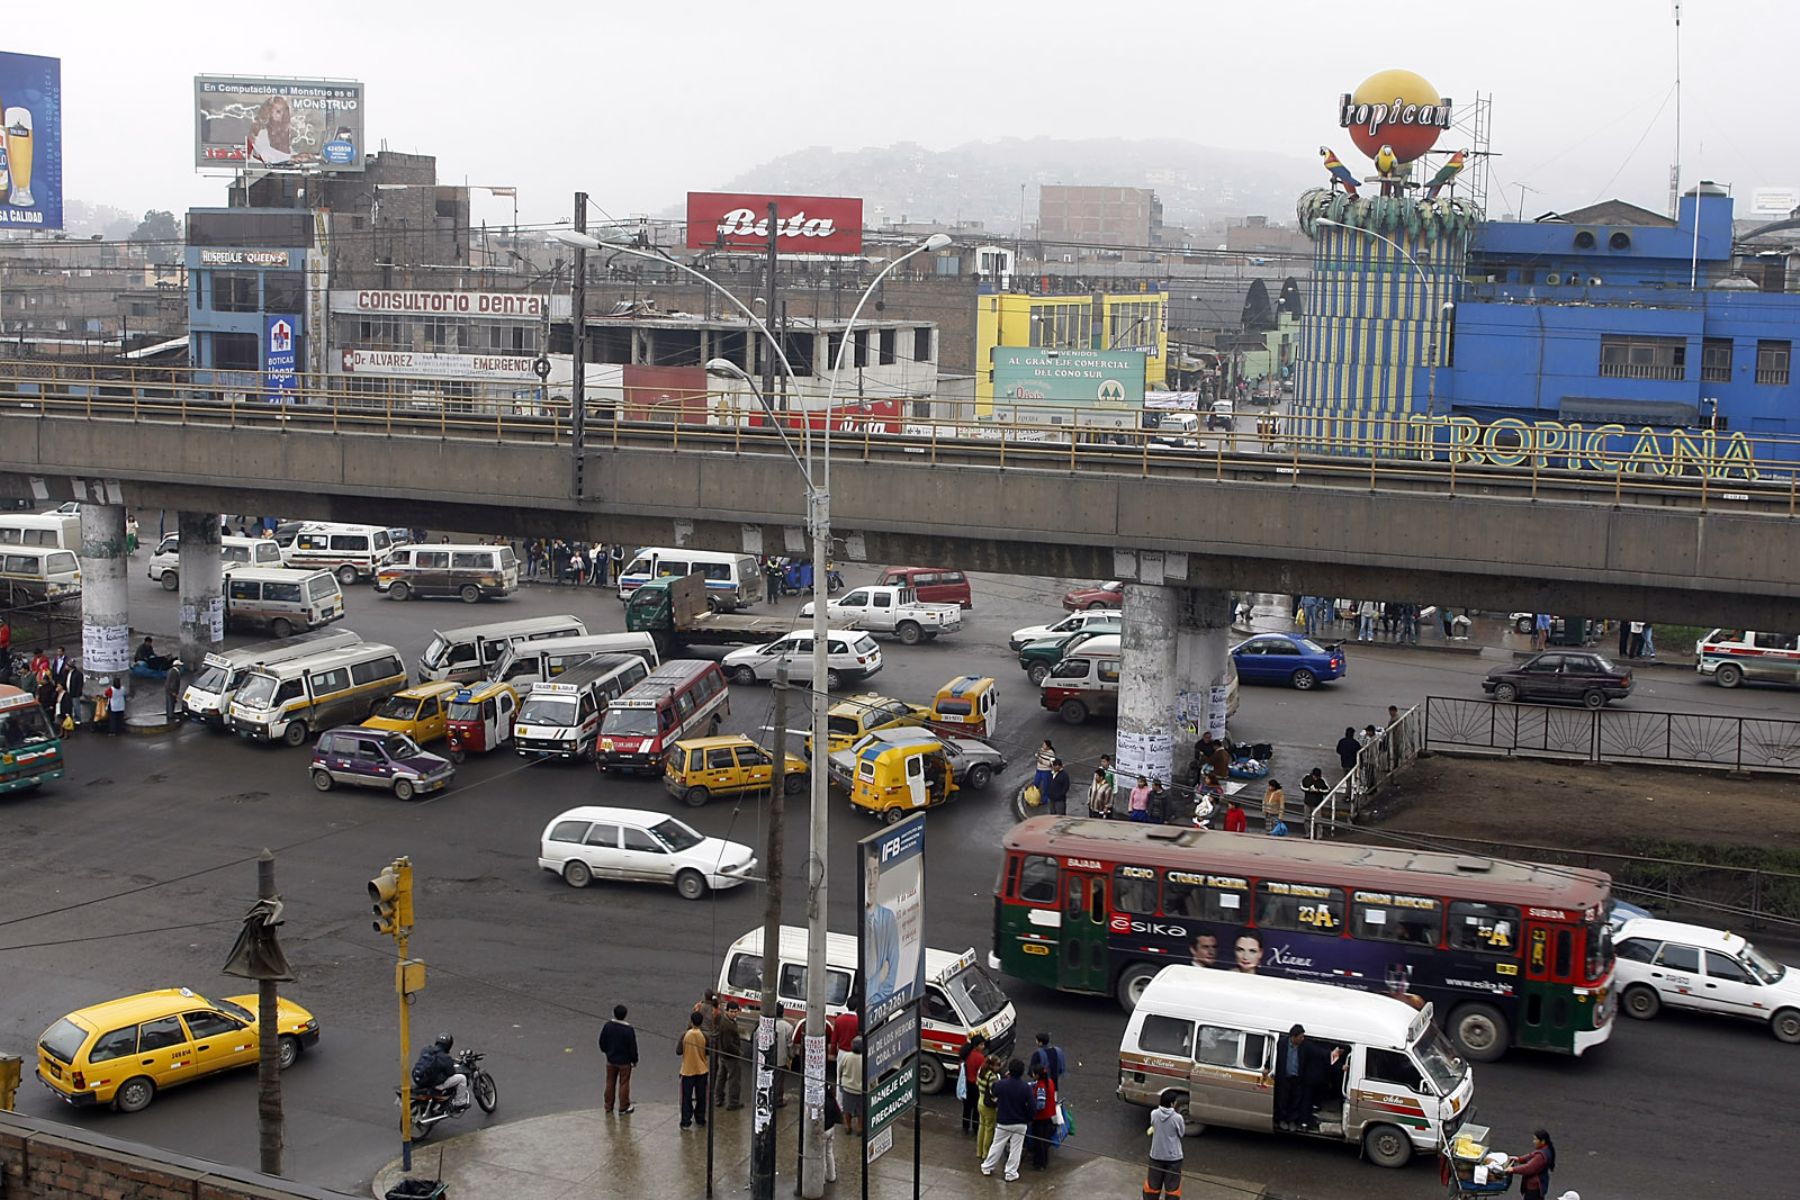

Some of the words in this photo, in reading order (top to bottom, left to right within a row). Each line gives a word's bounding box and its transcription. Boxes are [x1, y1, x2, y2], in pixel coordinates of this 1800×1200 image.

[204, 83, 216, 91] En
[218, 84, 278, 95] Computación
[279, 86, 288, 94] el
[290, 87, 332, 97] Monstruo
[347, 89, 354, 98] el
[293, 99, 357, 110] MONSTRUO
[10, 209, 43, 224] CALIDAD
[715, 208, 836, 238] Bata
[369, 353, 413, 368] ALVAREZ
[1040, 349, 1098, 357] BIVENIDOS
[268, 356, 294, 366] BOTICAS
[1055, 359, 1073, 367] EJE
[1074, 360, 1131, 369] COMERCIAL
[268, 366, 294, 383] Hogar
[1034, 369, 1053, 377] DEL
[1054, 369, 1082, 378] CONO
[1410, 415, 1760, 480] TROPICANA
[882, 836, 901, 862] IFB
[1067, 858, 1102, 869] BAJADA
[1529, 908, 1566, 920] SUBIDA
[744, 991, 762, 1000] ACH
[883, 1031, 894, 1046] LOS
[870, 1079, 899, 1107] MANEJE
[899, 1068, 913, 1086] CON
[871, 1088, 913, 1128] PRECAUCIÓN
